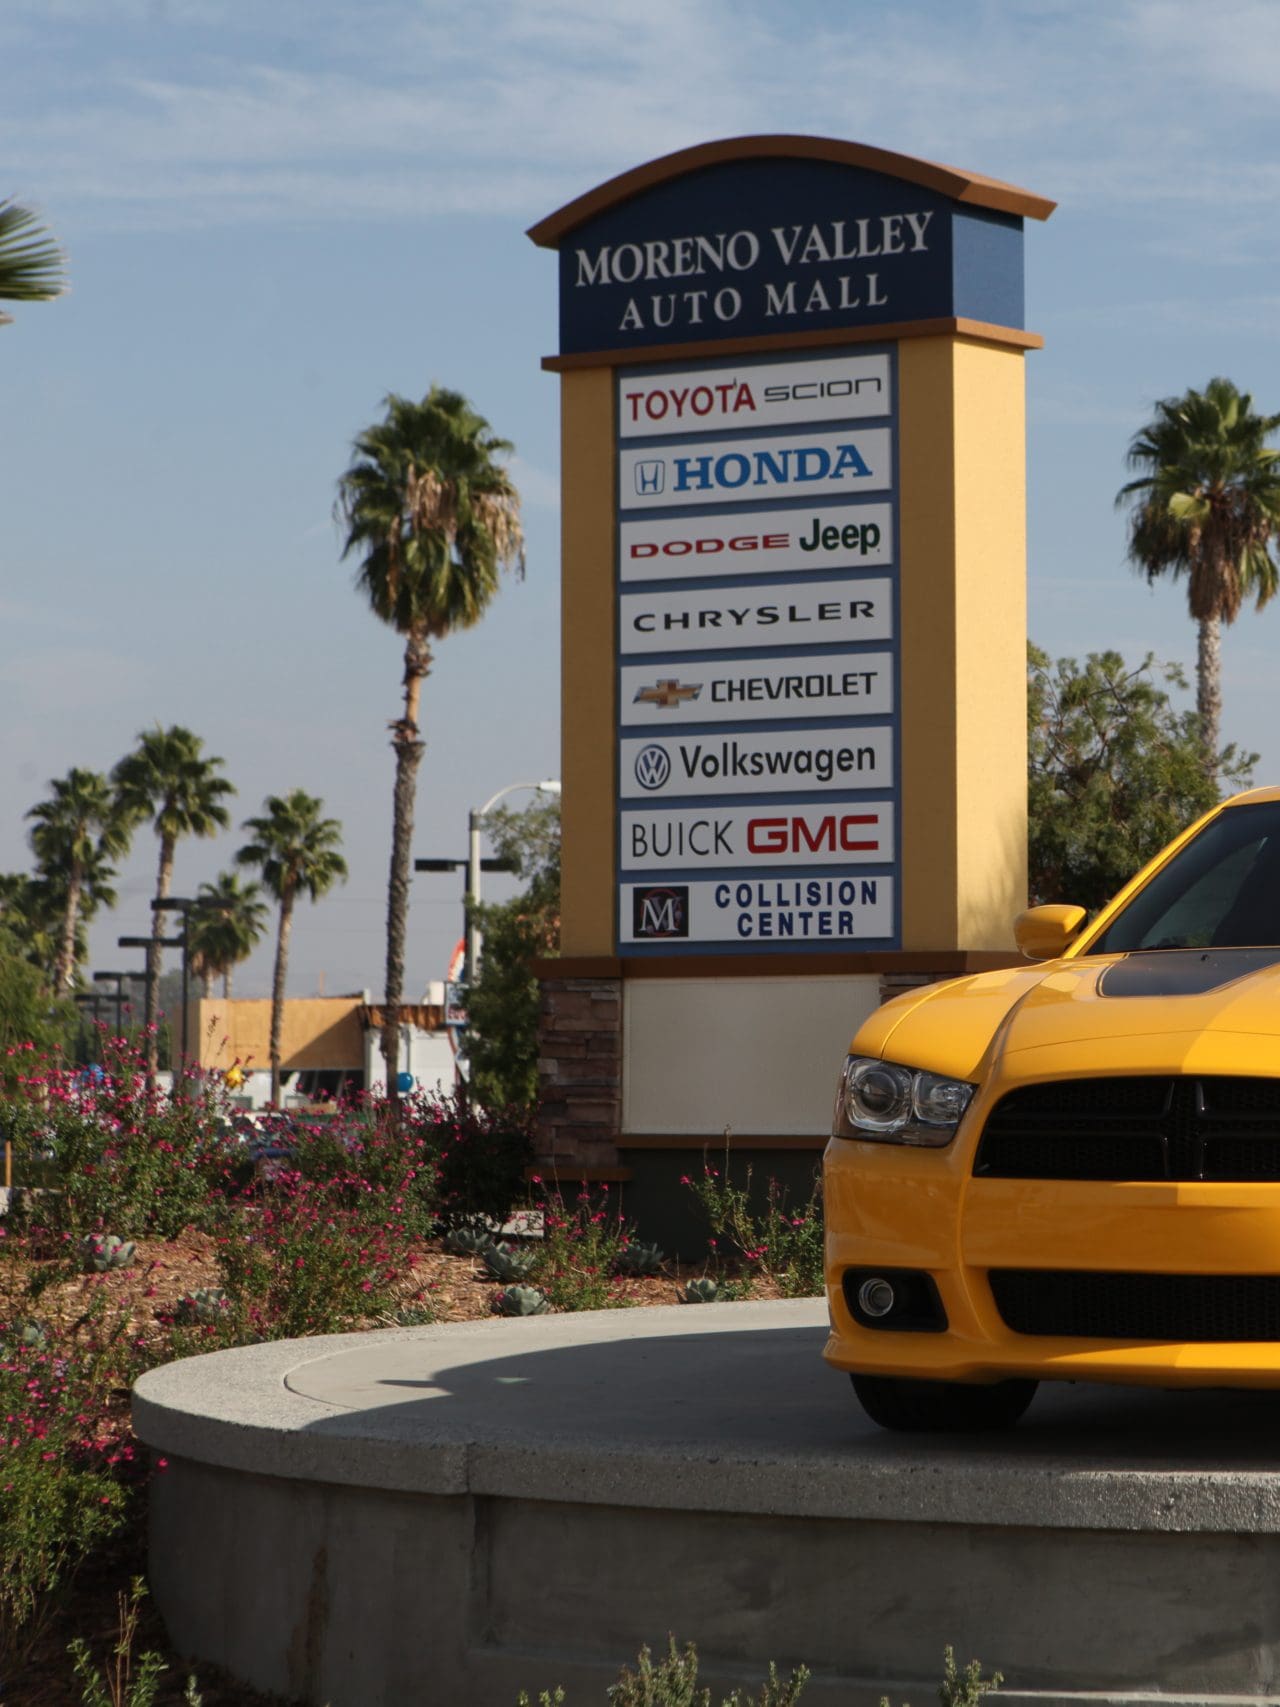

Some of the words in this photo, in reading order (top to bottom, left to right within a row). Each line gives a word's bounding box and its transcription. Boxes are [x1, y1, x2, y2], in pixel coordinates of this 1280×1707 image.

[575, 230, 760, 287] MORENO
[771, 211, 934, 266] VALLEY
[618, 287, 742, 330] AUTO
[764, 273, 888, 316] MALL
[626, 383, 756, 421] TOYOTA
[673, 444, 873, 491] HONDA
[630, 533, 790, 558] DODGE
[799, 518, 881, 555] Jeep
[633, 601, 875, 632] CHRYSLER
[711, 672, 878, 702] CHEVROLET
[679, 742, 876, 781] Volkswagen
[632, 820, 734, 857] BUICK
[747, 814, 879, 854] GMC
[715, 881, 877, 908] COLLISION
[737, 911, 854, 937] CENTER
